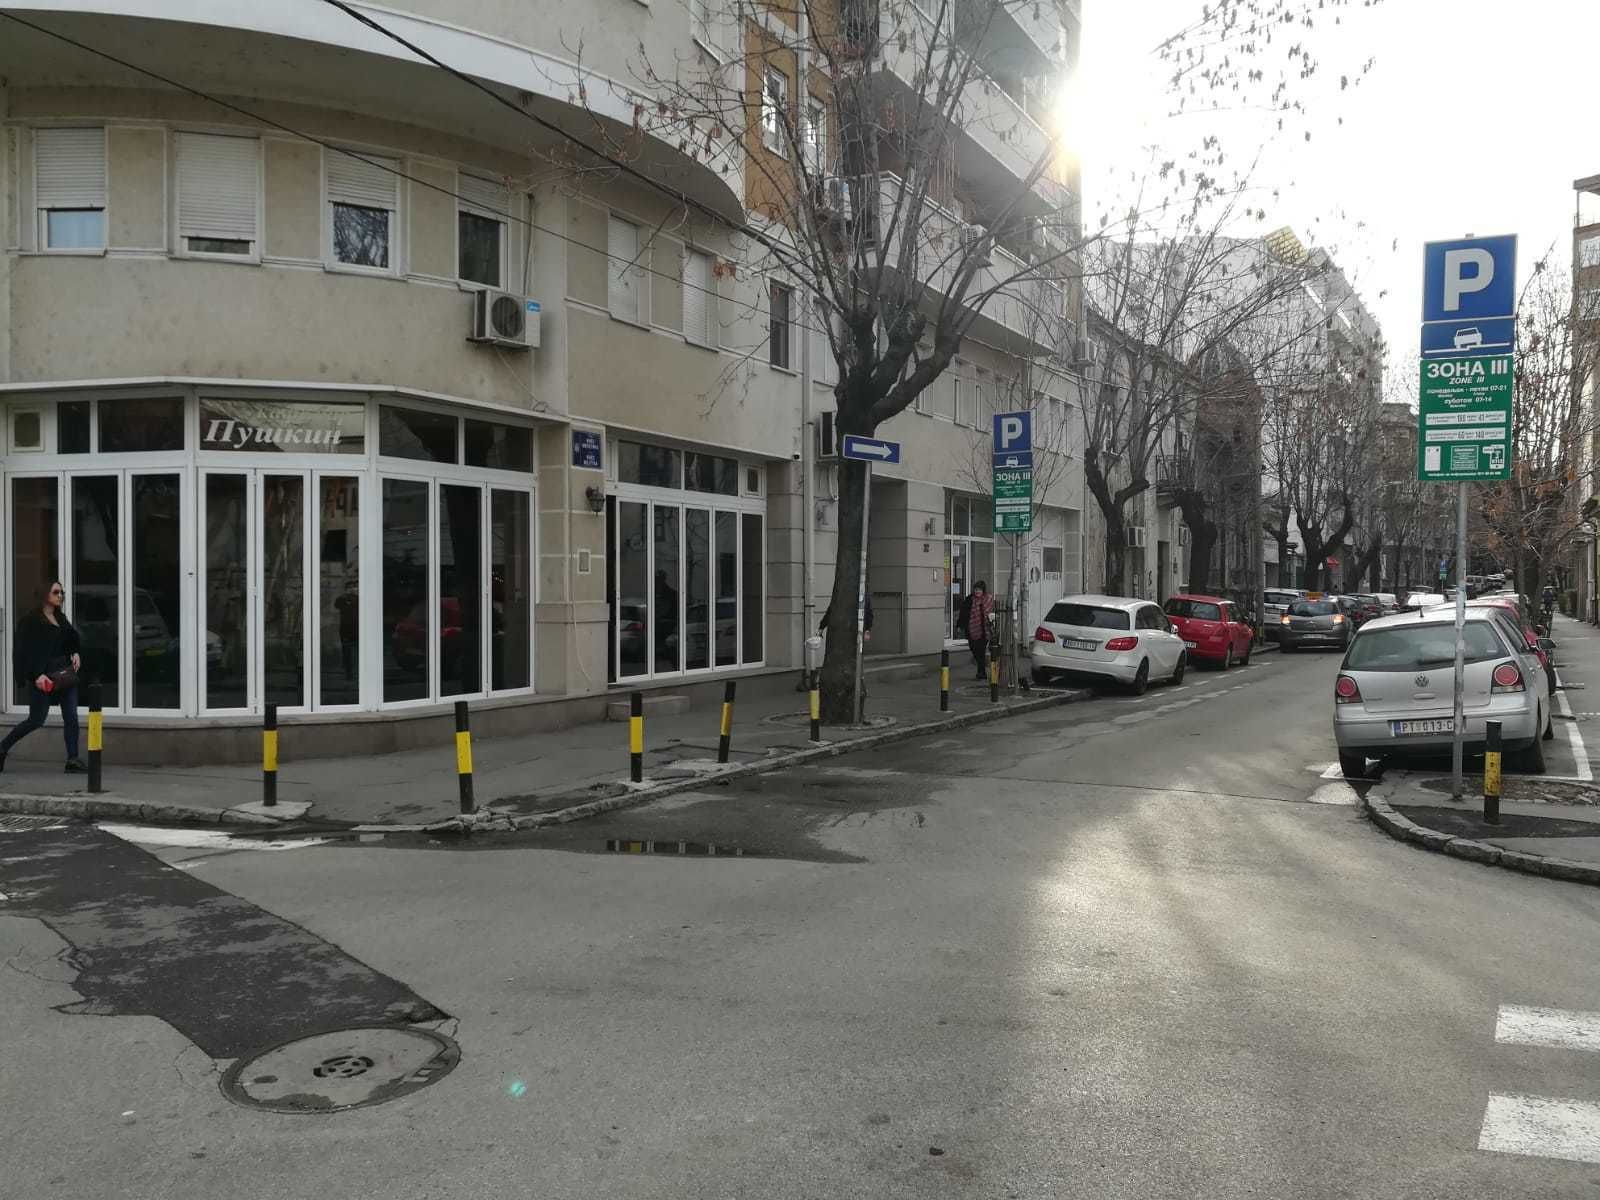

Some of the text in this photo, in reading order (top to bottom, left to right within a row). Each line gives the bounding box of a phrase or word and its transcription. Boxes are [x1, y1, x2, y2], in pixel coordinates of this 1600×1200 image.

[1443, 248, 1495, 312] P
[1427, 359, 1508, 378] ЗОНА III
[1449, 376, 1473, 385] ZONE
[203, 419, 342, 449] Пушкин
[1001, 416, 1023, 448] P
[996, 472, 1021, 481] ЗОНА
